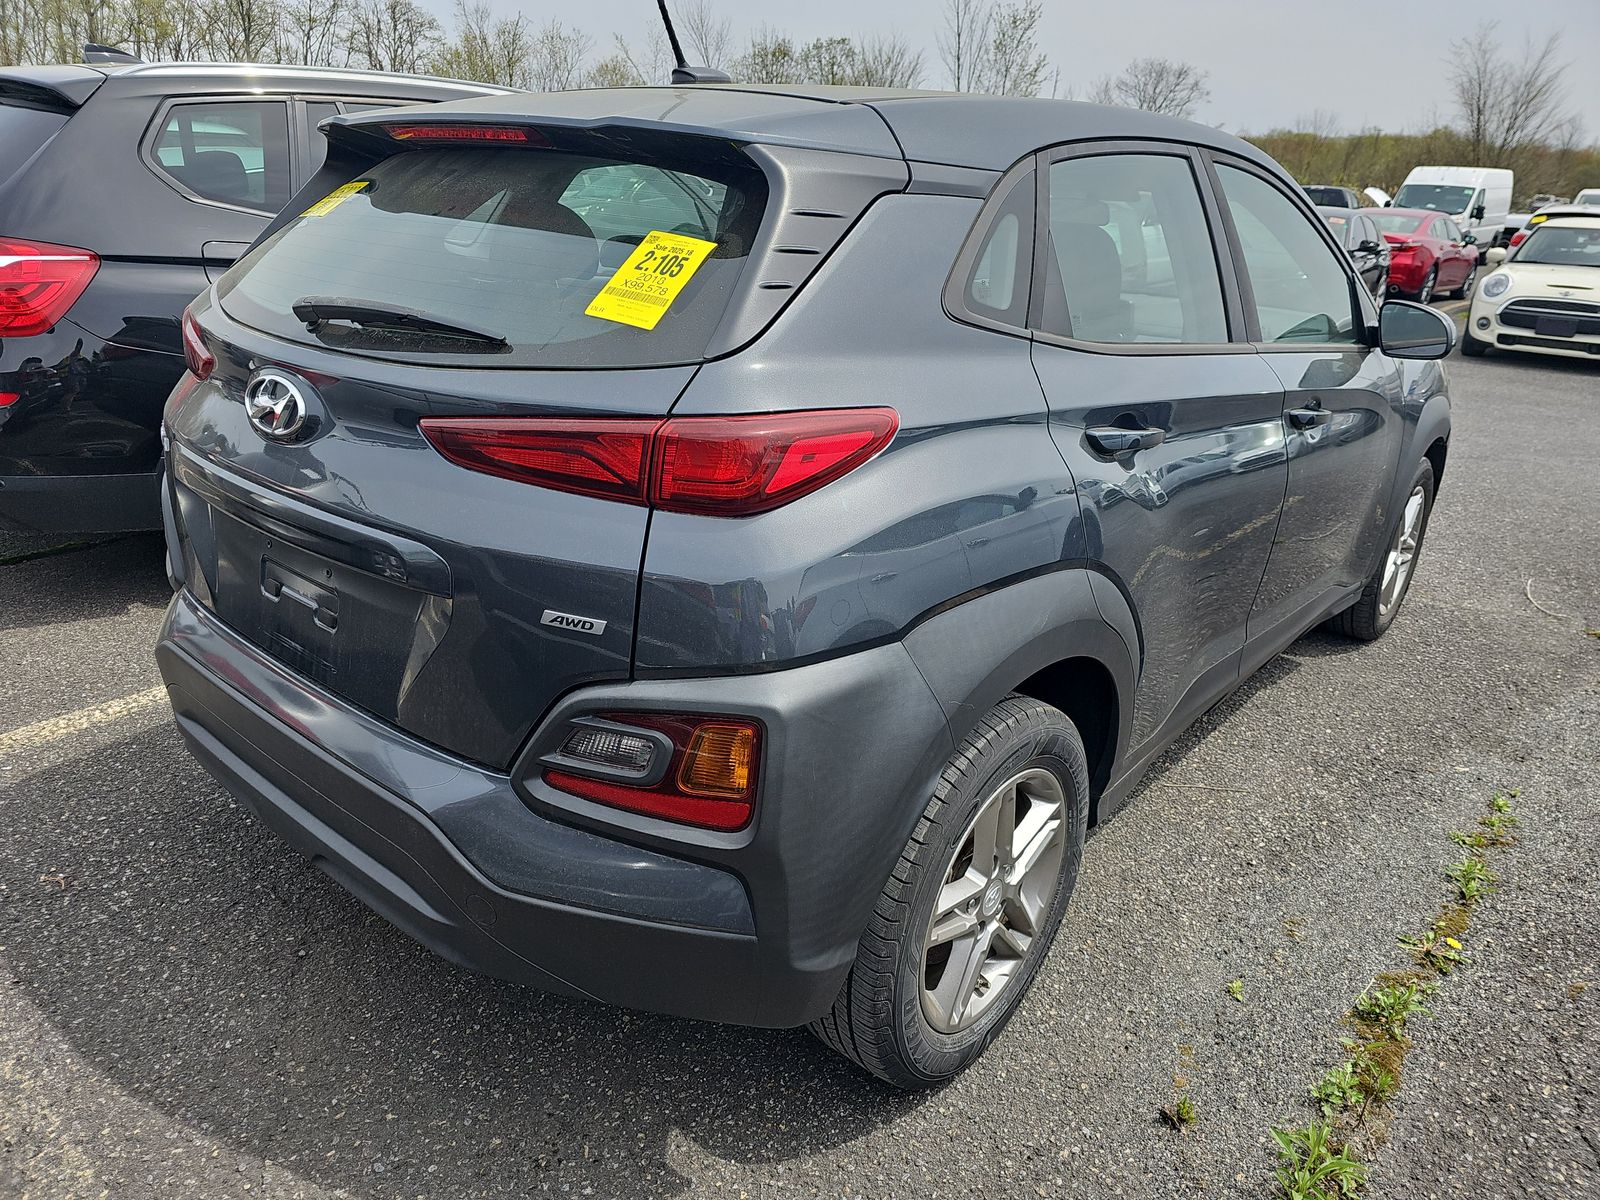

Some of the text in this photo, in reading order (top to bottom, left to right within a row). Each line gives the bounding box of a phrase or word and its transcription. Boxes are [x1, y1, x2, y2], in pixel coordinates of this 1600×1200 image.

[653, 243, 668, 252] Sale
[634, 250, 690, 278] 2:105
[635, 272, 667, 285] 2018
[549, 616, 595, 630] AWD
